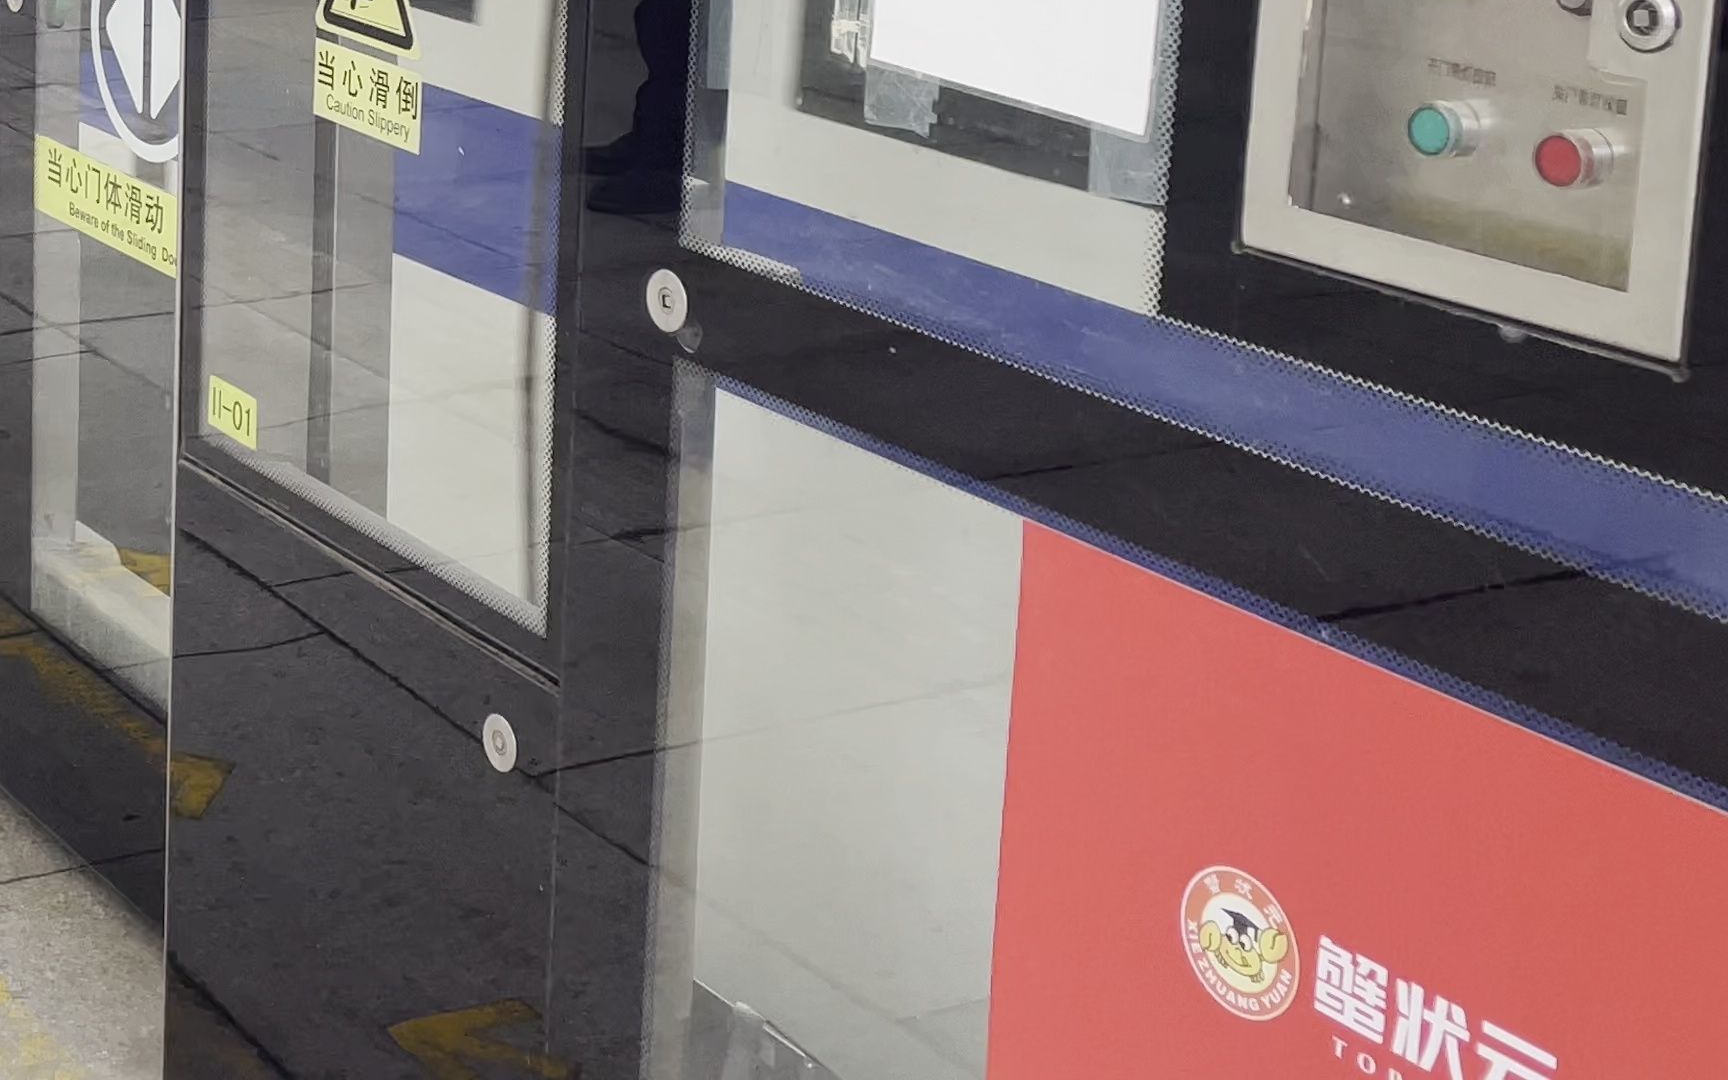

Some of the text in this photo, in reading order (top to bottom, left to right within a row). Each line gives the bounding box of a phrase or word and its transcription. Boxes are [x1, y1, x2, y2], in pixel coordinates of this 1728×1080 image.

[317, 50, 419, 120] 当心滑倒
[325, 94, 411, 144] Caution Slippery
[47, 147, 165, 235] 当心门体滑动
[69, 201, 99, 229] Beware
[101, 219, 111, 234] of
[112, 222, 124, 242] the
[126, 229, 157, 261] Sliding
[1186, 918, 1204, 954] XIE
[1261, 968, 1293, 1009] YUAN
